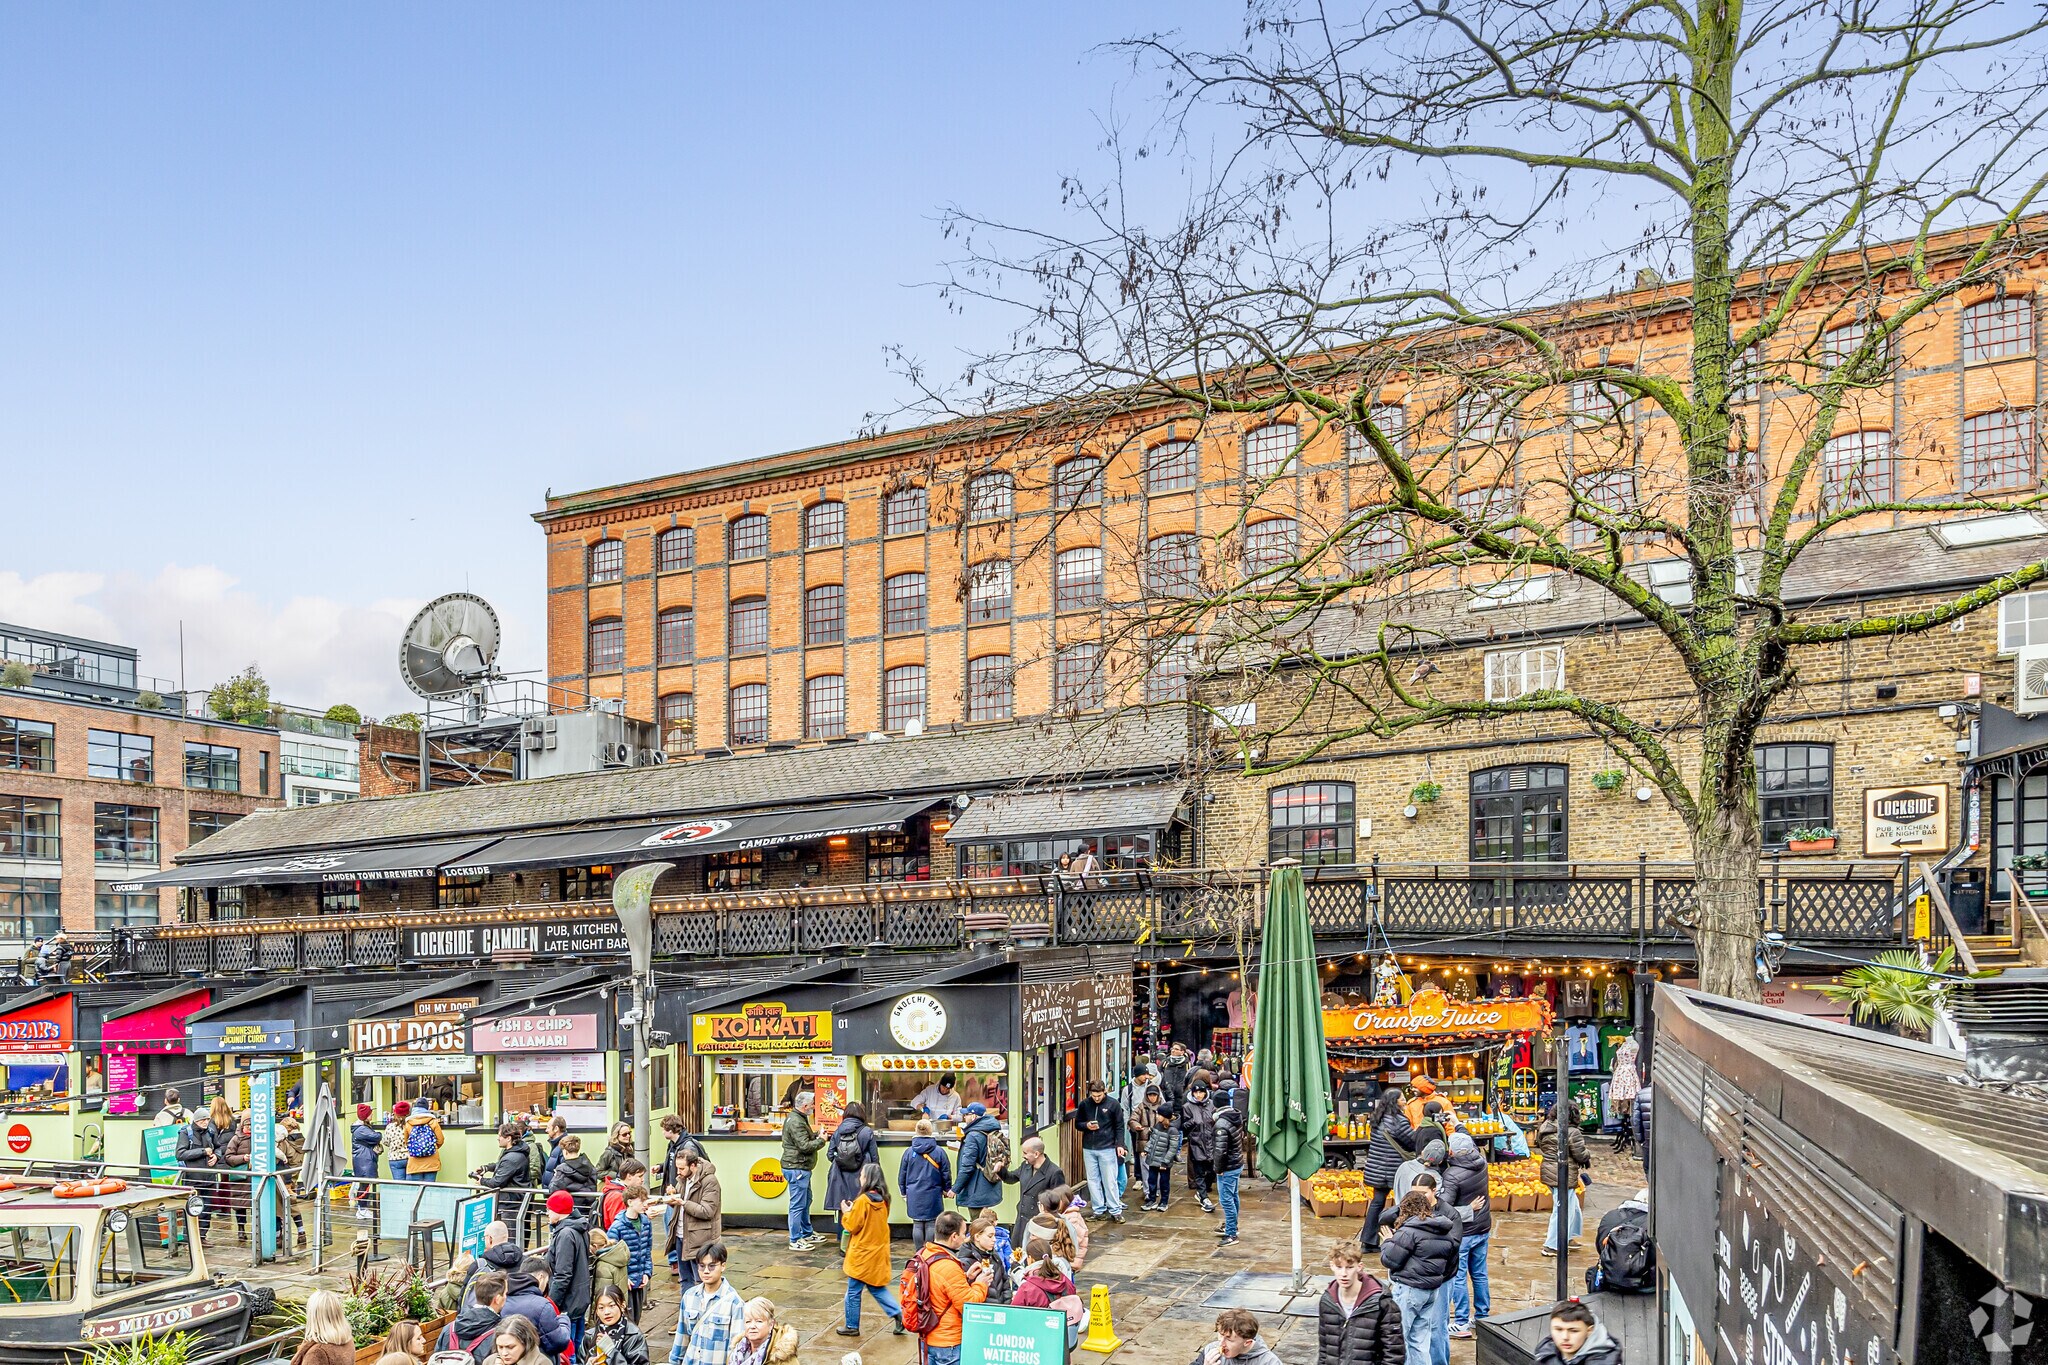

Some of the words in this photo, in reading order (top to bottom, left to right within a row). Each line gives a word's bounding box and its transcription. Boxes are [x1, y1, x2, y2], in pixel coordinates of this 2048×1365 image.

[1877, 797, 1936, 817] LOCKSIDE
[738, 837, 785, 849] CAMDEN
[788, 832, 822, 841] TOWN
[823, 825, 886, 837] BREWERY
[322, 872, 356, 881] CAMDEN
[357, 870, 382, 880] TOWN
[384, 869, 424, 878] BREWERY
[445, 867, 490, 877] LOCKSIDE
[112, 883, 144, 892] LOCKSIDE
[413, 929, 475, 956] LOCKSIDE
[483, 926, 539, 953] CAMDEN
[546, 925, 570, 938] PUB,
[573, 923, 618, 936] KITCHEN
[544, 940, 569, 952] LATE
[571, 939, 603, 951] NIGHT
[606, 938, 629, 949] BAR
[419, 1003, 431, 1014] OH
[434, 1002, 448, 1013] MY
[894, 996, 926, 1017] GNOCCHI
[928, 1000, 943, 1017] BAR
[695, 1017, 706, 1026] 03
[1031, 1009, 1048, 1024] WEST
[1048, 1006, 1063, 1020] YARD
[1353, 1011, 1438, 1032] Orange
[1440, 1008, 1503, 1029] Juice
[185, 1026, 193, 1035] 09
[225, 1025, 262, 1035] INDONESIAN
[497, 1020, 521, 1032] FISH
[523, 1019, 534, 1032] &
[536, 1018, 573, 1031] CHIPS
[711, 1015, 818, 1040] KOLKATI
[838, 1018, 848, 1029] 01
[220, 1034, 247, 1044] OCONUT
[247, 1034, 268, 1043] CURRY
[357, 1022, 402, 1051] HOT
[407, 1021, 465, 1050] DOGS
[501, 1035, 568, 1048] CALAMARI
[893, 1025, 916, 1047] CAMDEN
[919, 1025, 943, 1047] MARKET
[698, 1042, 718, 1051] KATI
[718, 1041, 746, 1050] ROLLS
[746, 1040, 769, 1050] FROM
[770, 1039, 809, 1050] KOLKATA
[809, 1039, 832, 1048] INDIA
[253, 1092, 267, 1173] WATERBUS
[118, 1305, 194, 1335] MILTON
[989, 1333, 1035, 1350] LONDON
[983, 1347, 1041, 1365] WATERBUS
